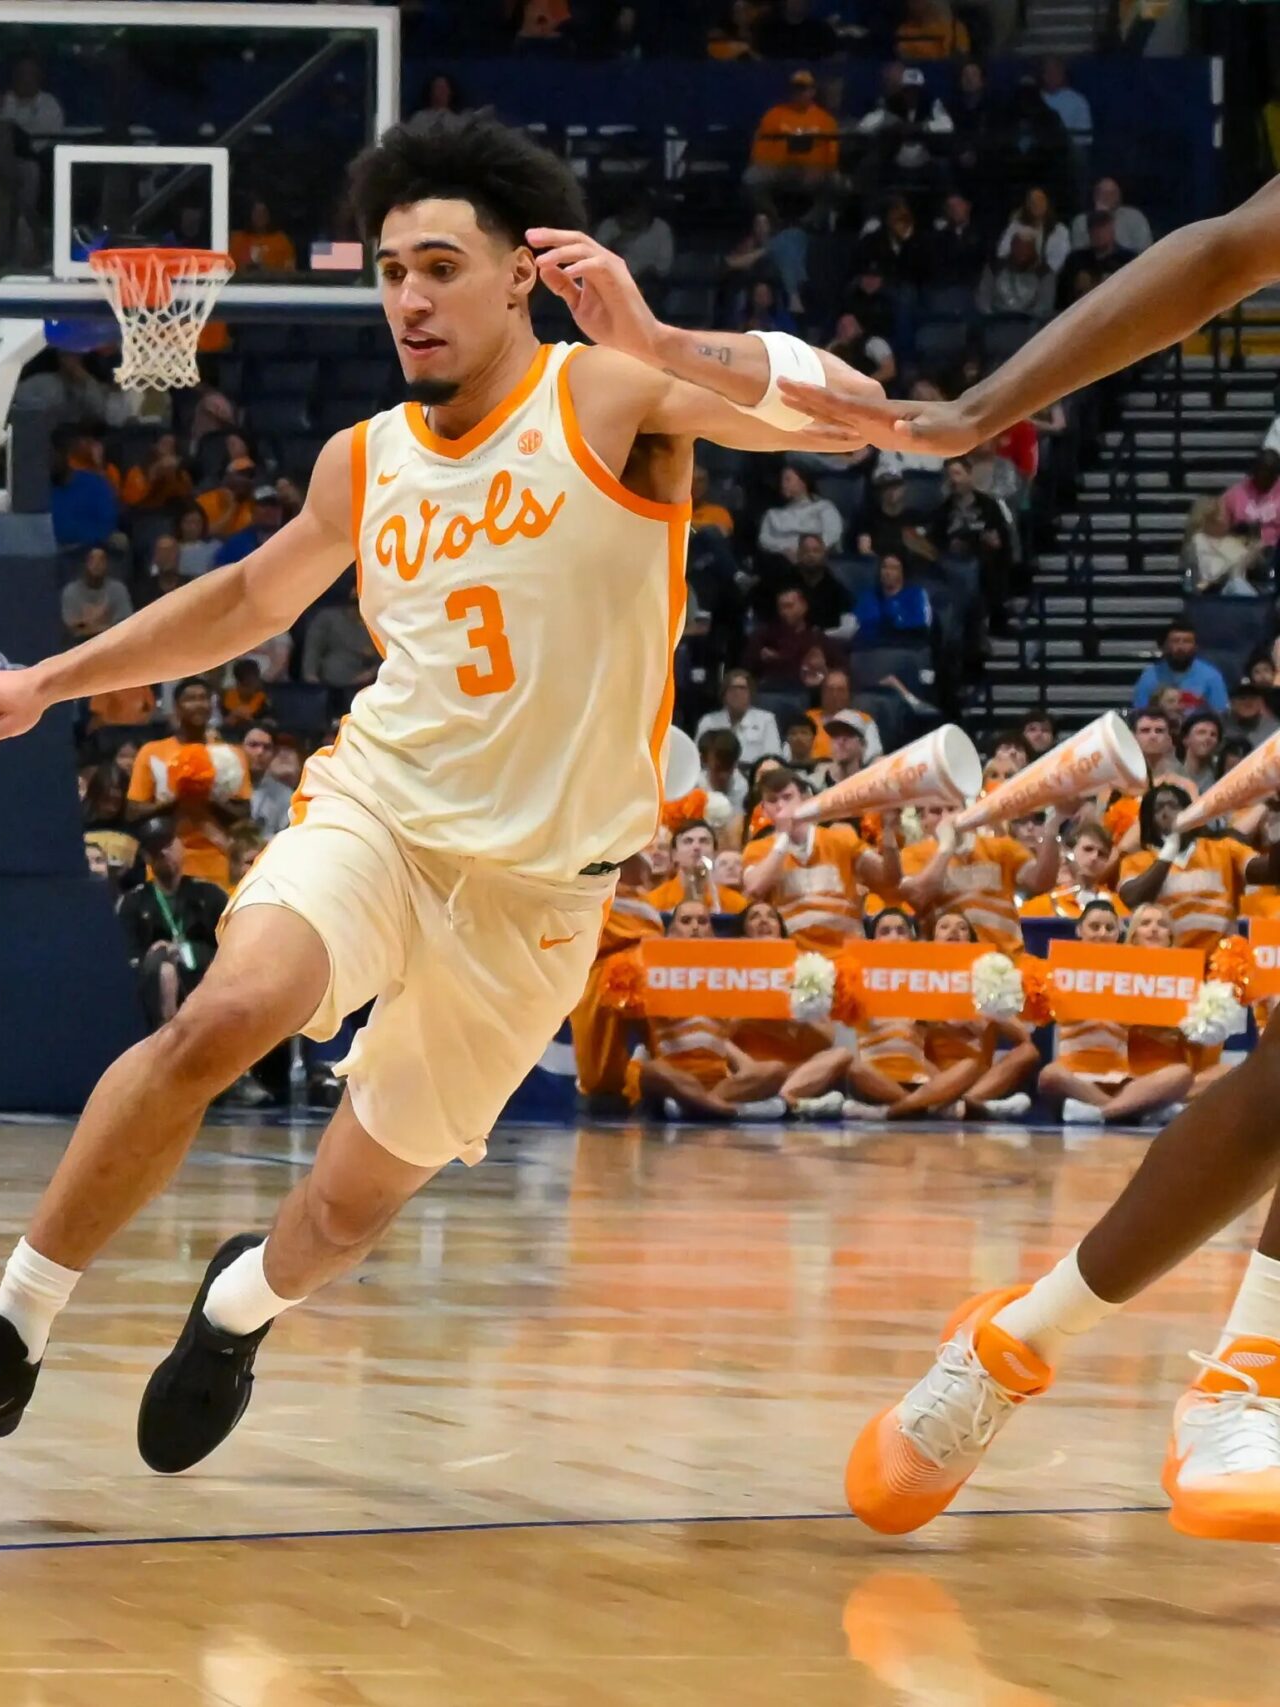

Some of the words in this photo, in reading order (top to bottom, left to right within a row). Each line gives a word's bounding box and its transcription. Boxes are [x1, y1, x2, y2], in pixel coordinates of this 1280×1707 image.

[375, 470, 566, 581] Vols
[444, 584, 517, 697] 3
[647, 966, 789, 991] DEFENSE
[1053, 967, 1196, 999] DEFENSE
